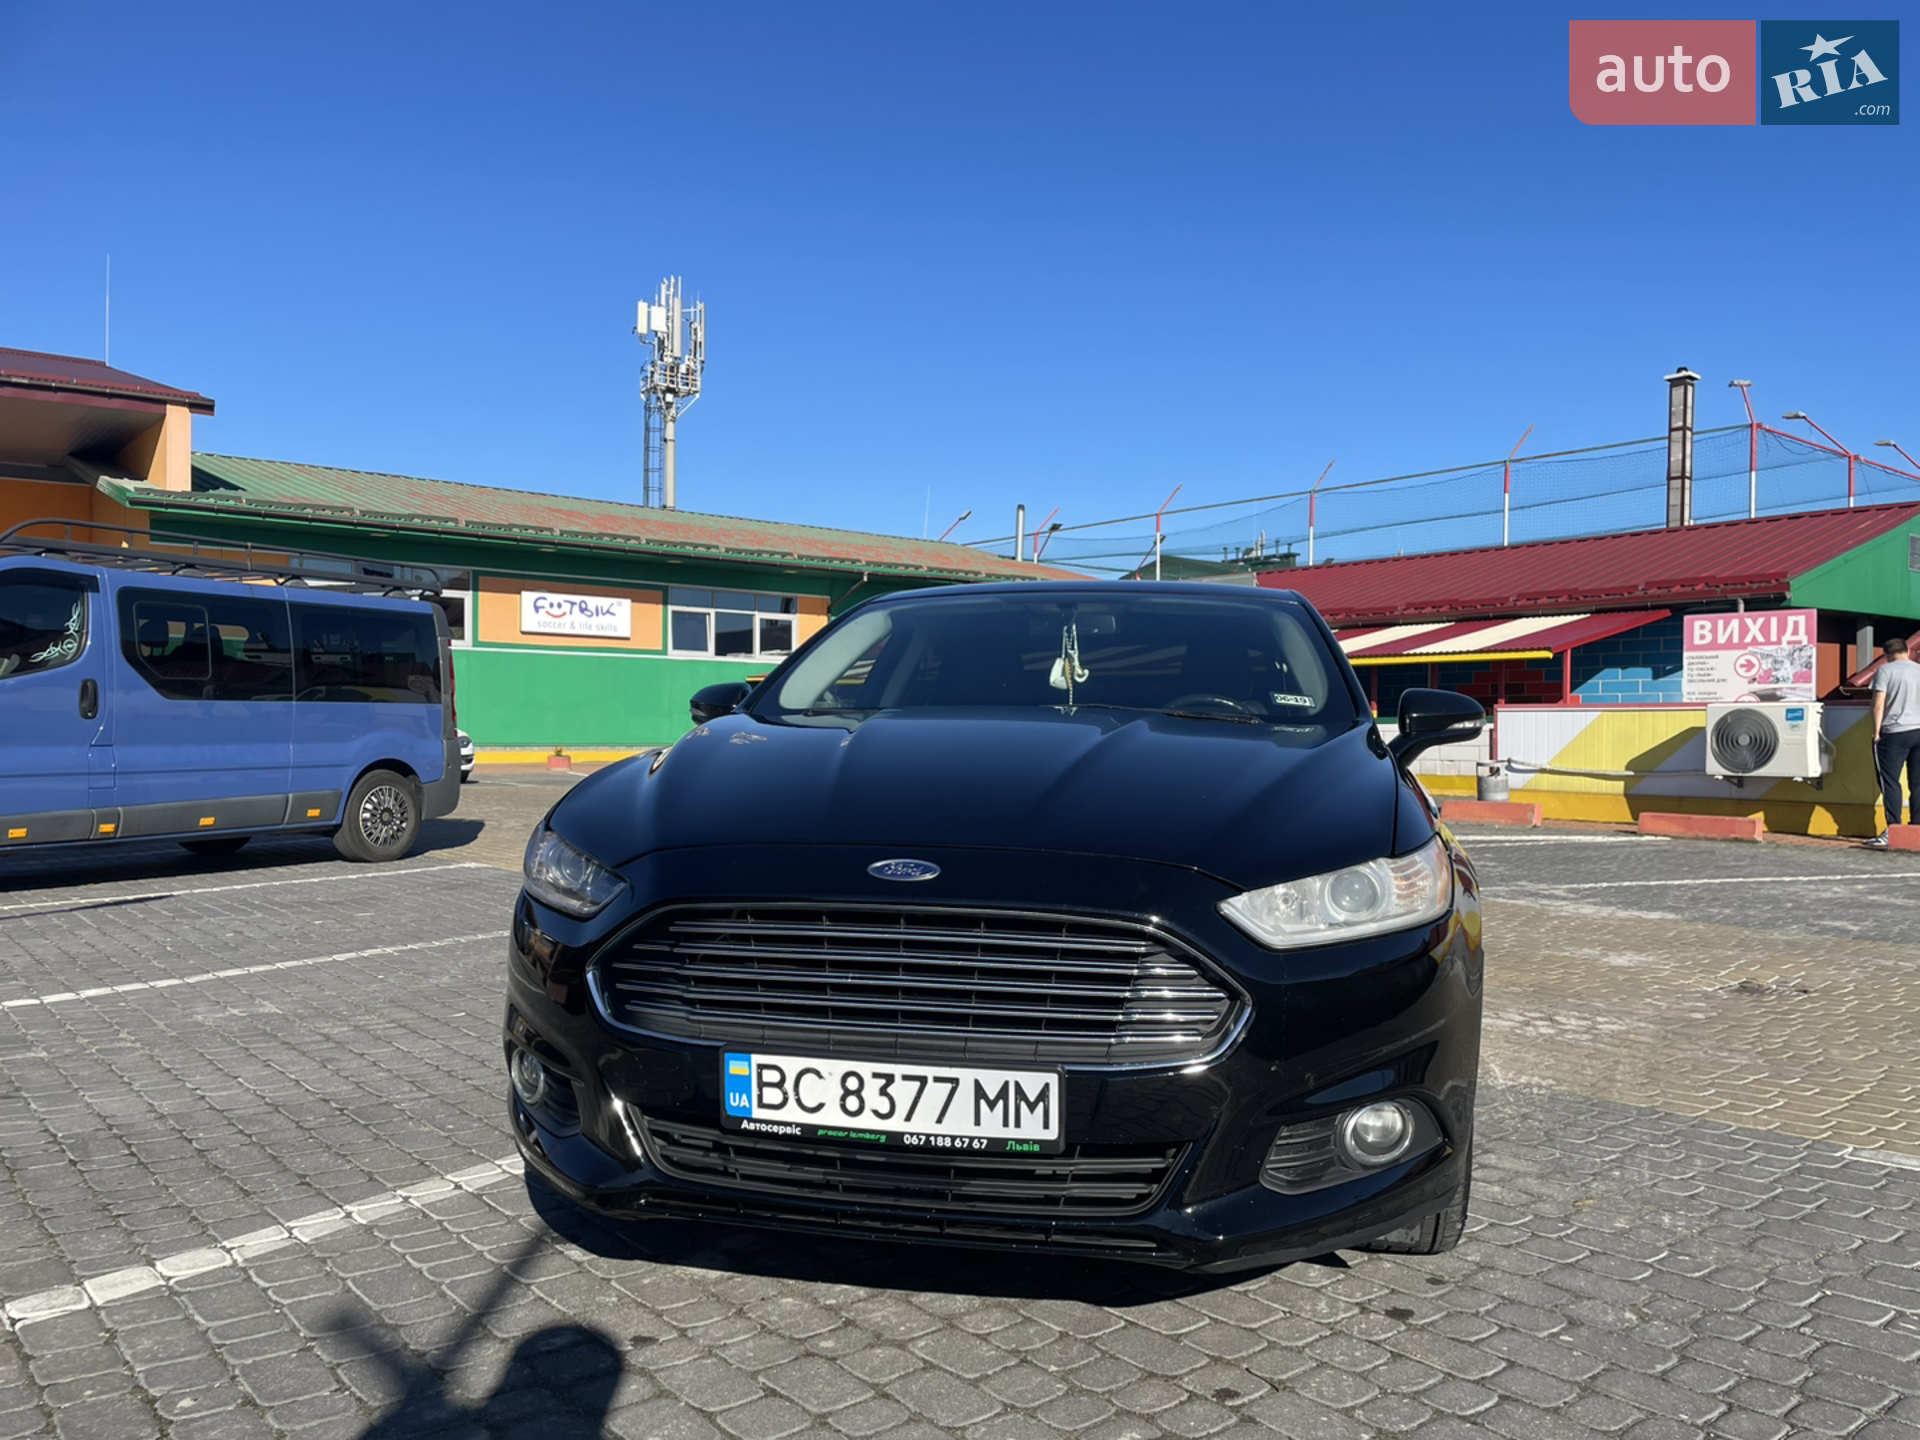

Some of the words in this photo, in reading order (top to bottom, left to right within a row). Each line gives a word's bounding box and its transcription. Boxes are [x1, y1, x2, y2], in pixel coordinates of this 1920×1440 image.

[537, 620, 566, 629] soccer
[569, 621, 576, 630] &
[579, 621, 593, 630] life
[595, 622, 618, 632] skills
[1692, 615, 1809, 646] ВИХІД
[729, 1092, 750, 1108] UA
[756, 1063, 826, 1114] BC
[839, 1070, 960, 1124] 8377
[973, 1078, 1050, 1130] MM
[740, 1119, 802, 1135] Автосервіс
[903, 1134, 926, 1146] 067
[929, 1135, 951, 1147] 188
[954, 1137, 970, 1148] 67
[972, 1138, 988, 1149] 67
[1005, 1140, 1040, 1152] Львів
